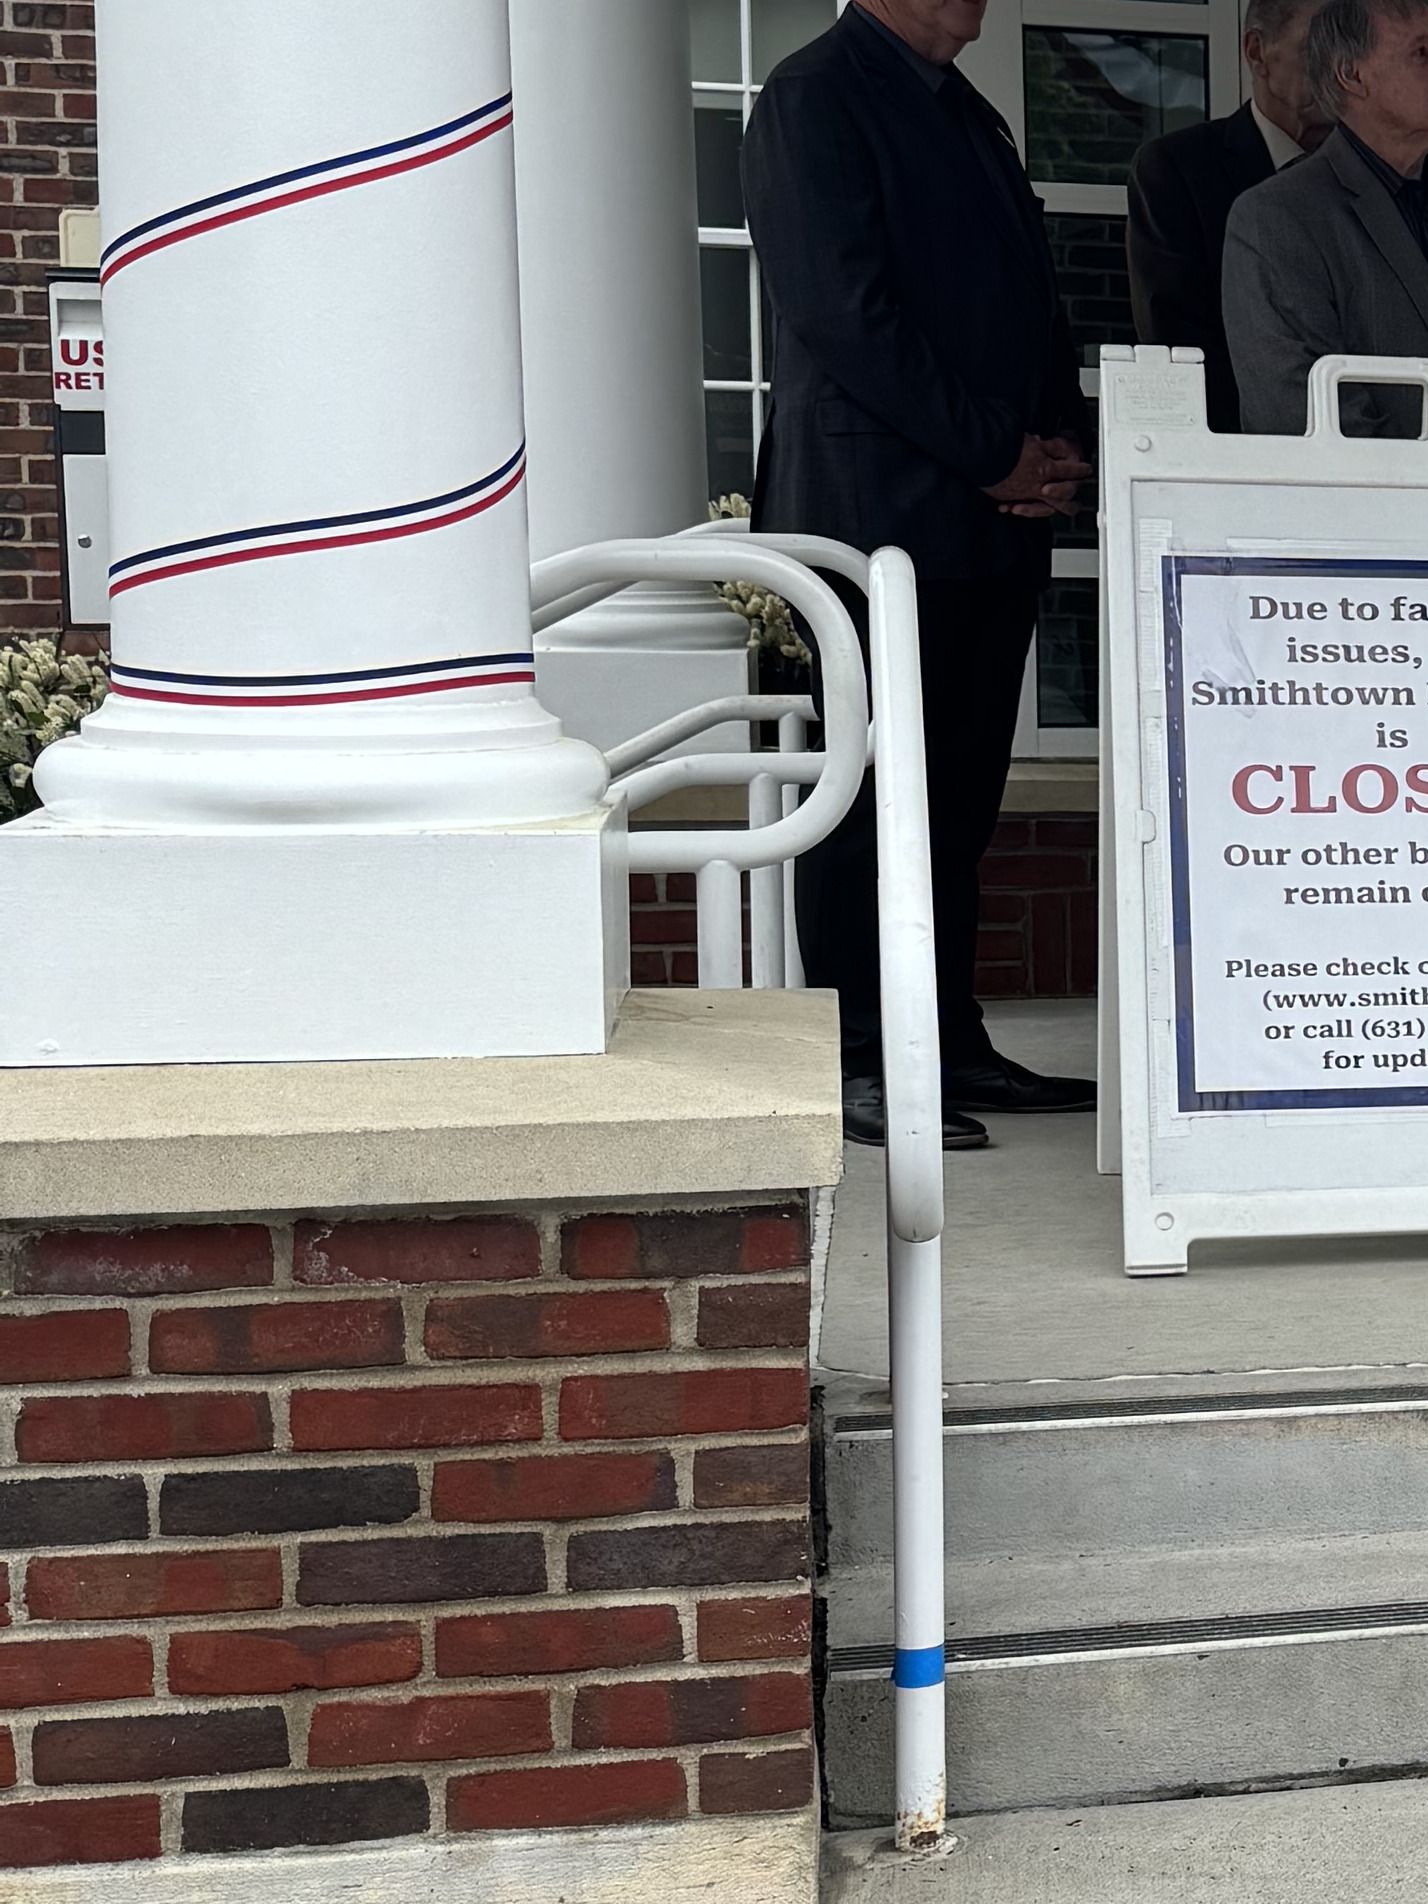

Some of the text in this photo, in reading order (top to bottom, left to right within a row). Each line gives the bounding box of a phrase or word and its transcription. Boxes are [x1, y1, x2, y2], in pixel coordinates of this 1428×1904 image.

[1249, 596, 1327, 620] Due
[1338, 598, 1379, 621] to
[1287, 637, 1422, 669] issues,
[1192, 679, 1416, 705] Smithtown
[1376, 722, 1408, 748] is
[1224, 844, 1291, 866] Our
[1301, 842, 1398, 865] other
[1284, 880, 1411, 904] remain
[1226, 959, 1317, 978] Please
[1326, 956, 1410, 976] check
[1265, 1026, 1295, 1039] or
[1303, 1019, 1353, 1038] call
[1362, 1018, 1425, 1040] (631)
[1323, 1050, 1364, 1069] for
